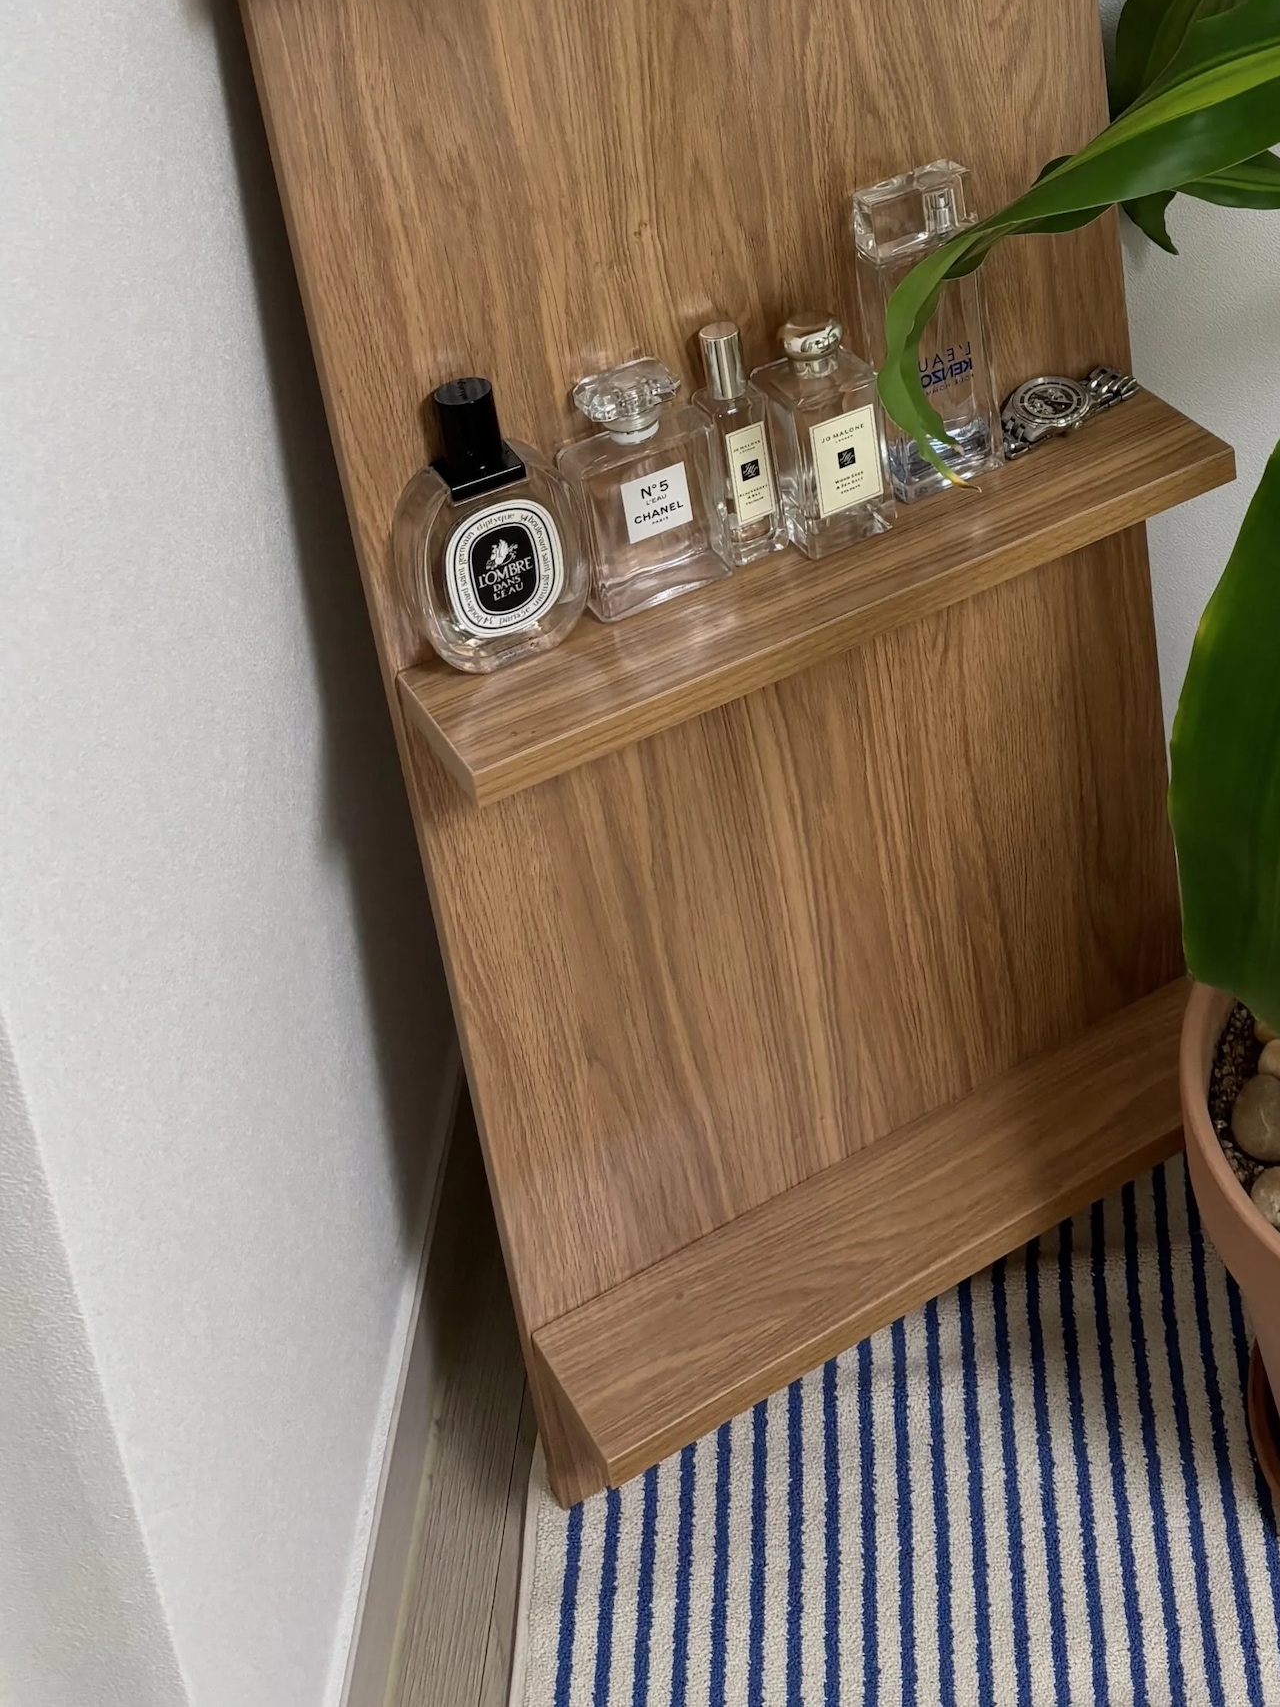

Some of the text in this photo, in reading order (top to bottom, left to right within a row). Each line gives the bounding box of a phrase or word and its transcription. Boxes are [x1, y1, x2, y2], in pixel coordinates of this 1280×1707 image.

[821, 423, 865, 444] JO MALONE
[646, 493, 667, 506] L'EAU
[476, 513, 515, 532] diptyque
[634, 500, 684, 525] CHANEL
[528, 515, 548, 553] boulevard
[541, 553, 552, 573] saint
[478, 556, 534, 589] L'OMBRE
[493, 574, 521, 592] DANS
[493, 581, 524, 601] L'EAU
